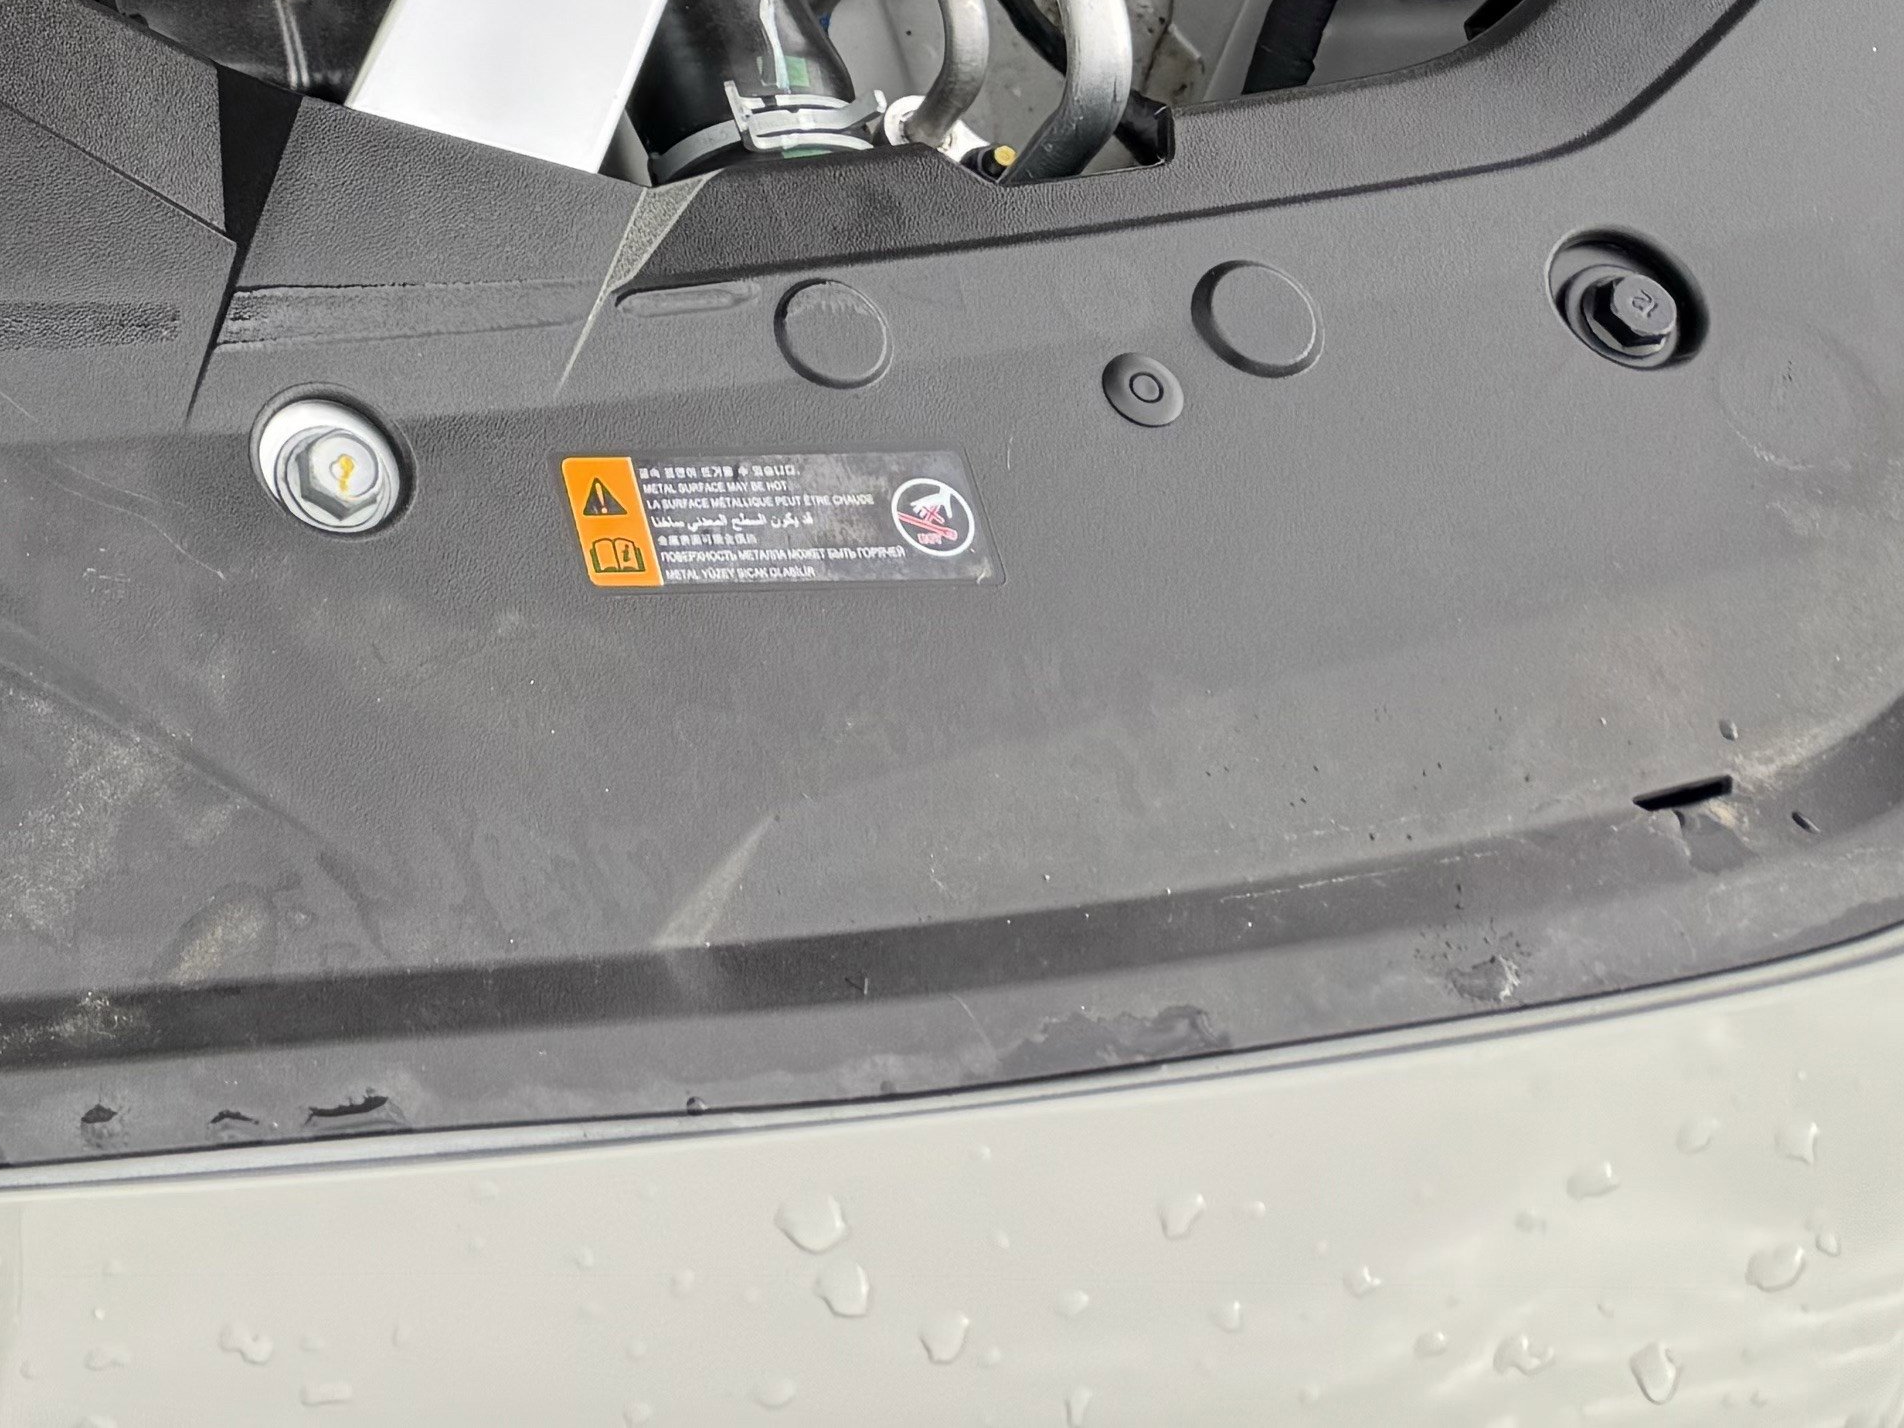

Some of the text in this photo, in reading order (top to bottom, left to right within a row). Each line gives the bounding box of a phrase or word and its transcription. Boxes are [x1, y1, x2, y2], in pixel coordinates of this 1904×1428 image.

[642, 483, 676, 495] METAL
[726, 481, 749, 493] MAY
[751, 481, 765, 492] BE
[766, 480, 788, 492] HOT
[647, 499, 659, 511] LA
[775, 495, 802, 507] PEUT
[666, 568, 698, 580] METAL
